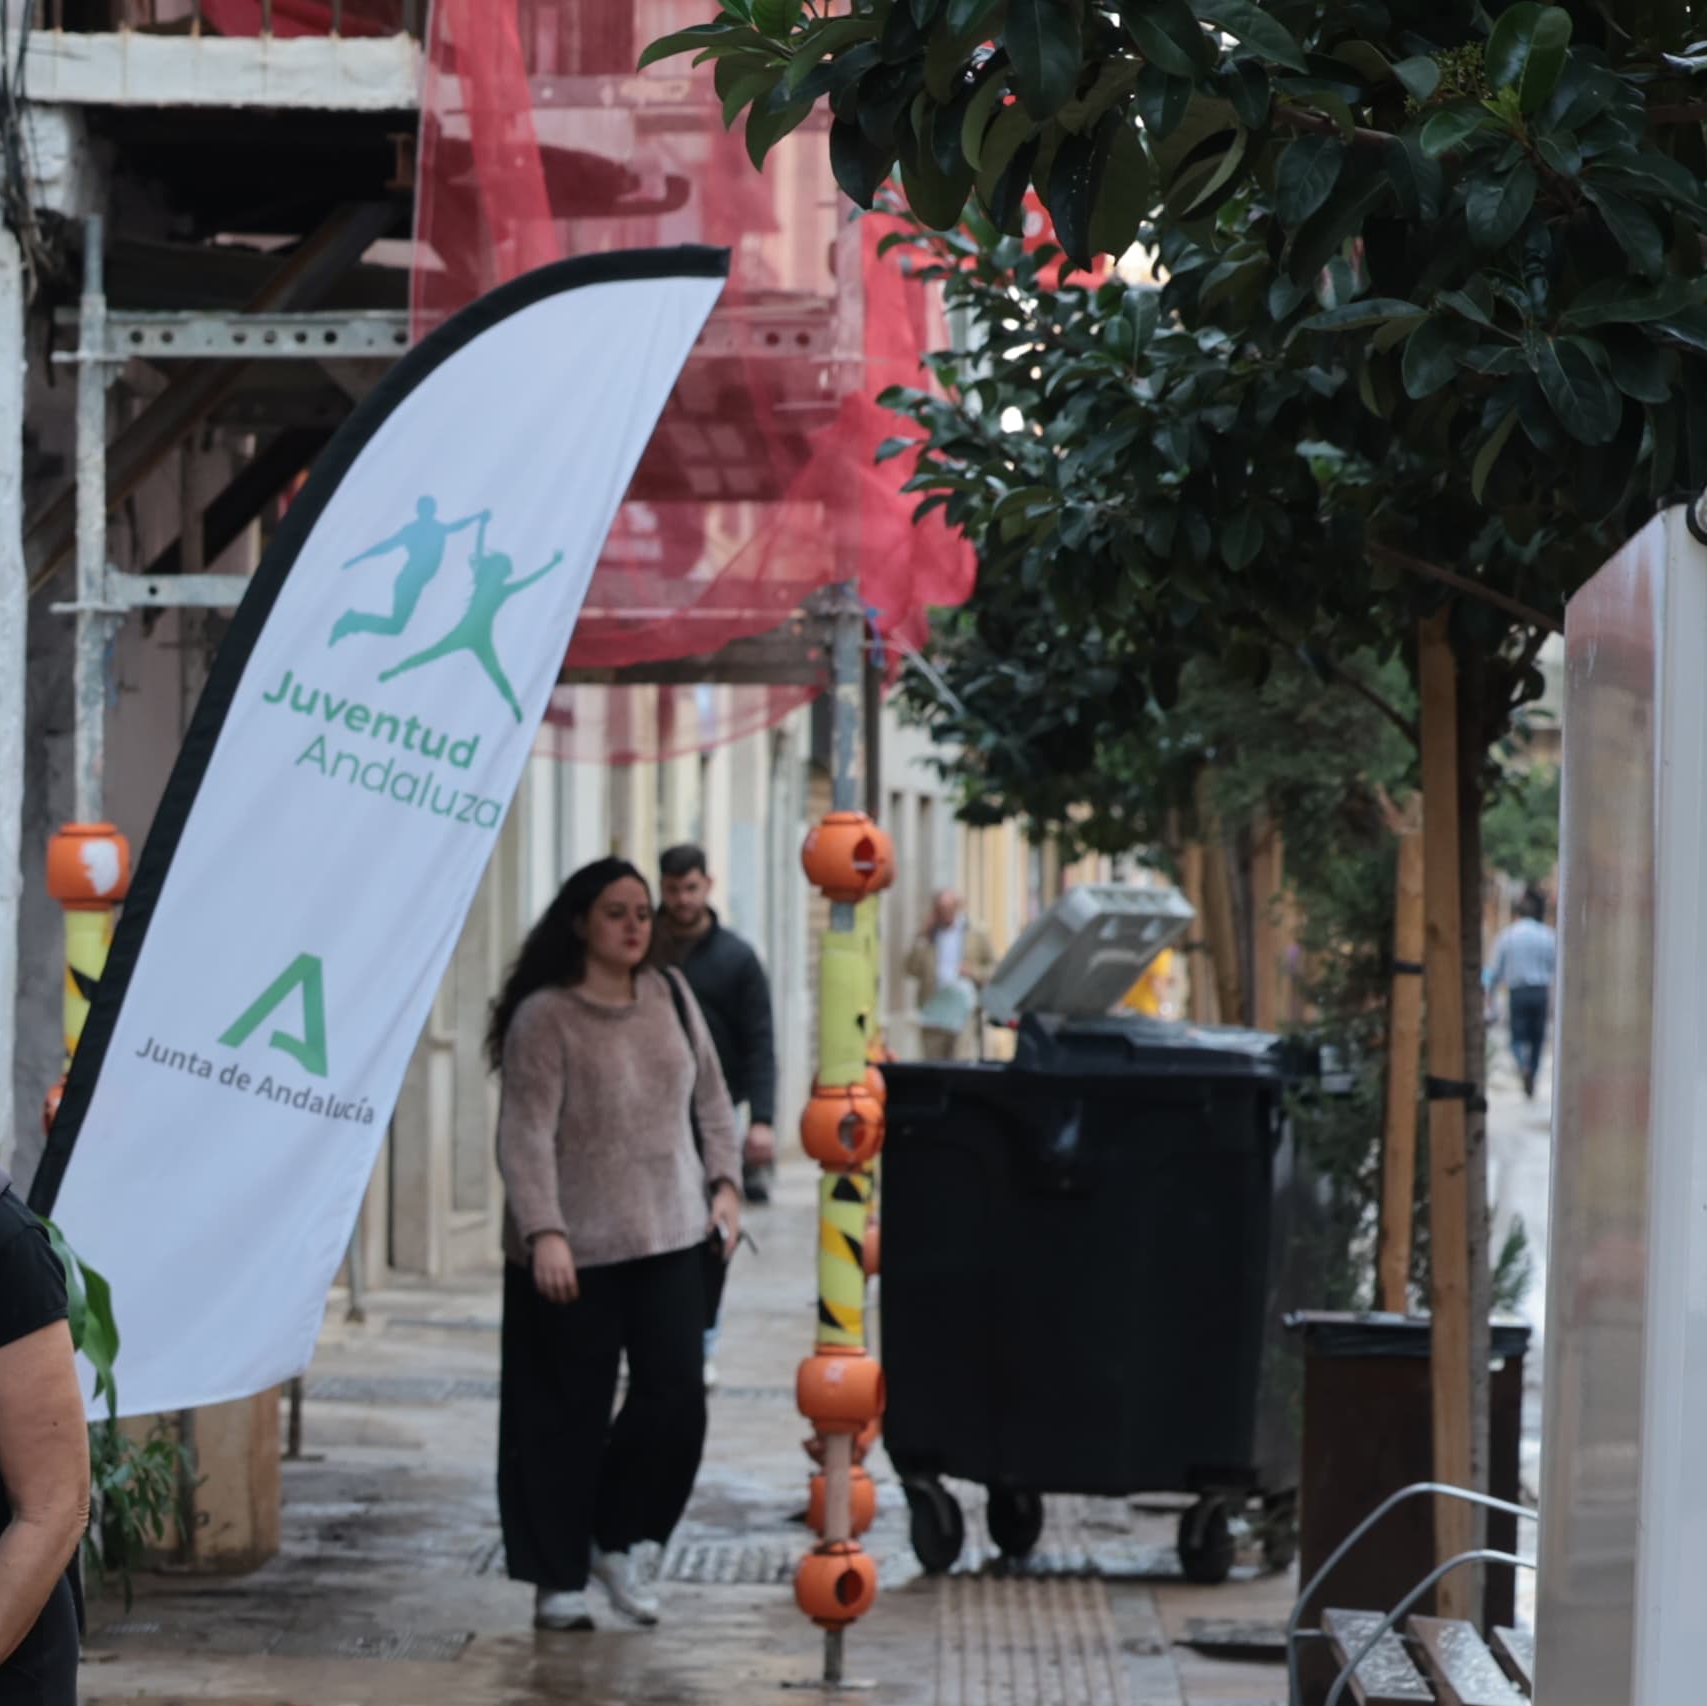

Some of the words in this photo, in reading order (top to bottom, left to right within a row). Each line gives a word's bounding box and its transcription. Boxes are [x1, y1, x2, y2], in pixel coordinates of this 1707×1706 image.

[263, 671, 480, 770] Juventud
[295, 734, 503, 829] Andaluza
[135, 1037, 213, 1079] Junta
[219, 1064, 251, 1092] de
[255, 1075, 375, 1125] Andalucía
